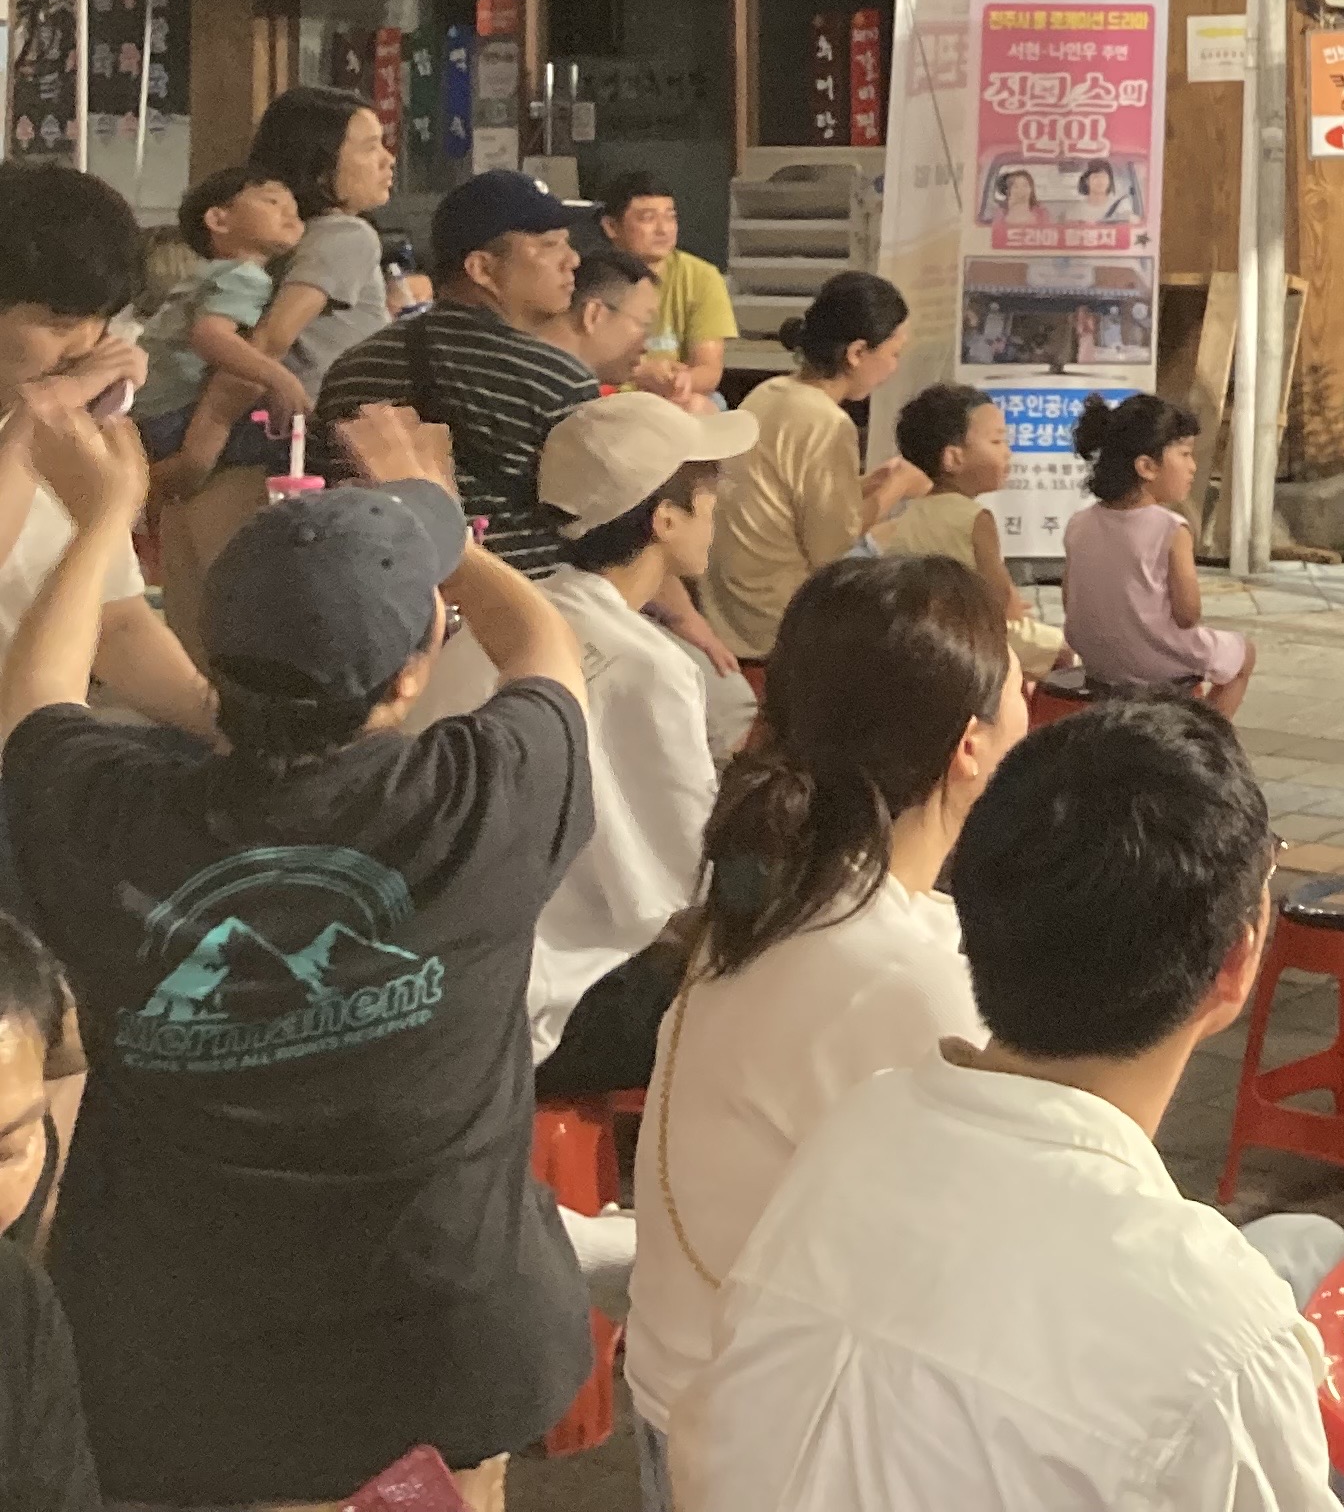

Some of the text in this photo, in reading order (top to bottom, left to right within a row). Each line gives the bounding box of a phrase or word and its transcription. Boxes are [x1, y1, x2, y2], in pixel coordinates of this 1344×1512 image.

[1107, 11, 1149, 30] 드라마
[984, 72, 1148, 115] 징크스의
[1018, 114, 1111, 159] 연인
[1006, 227, 1059, 247] 드라마
